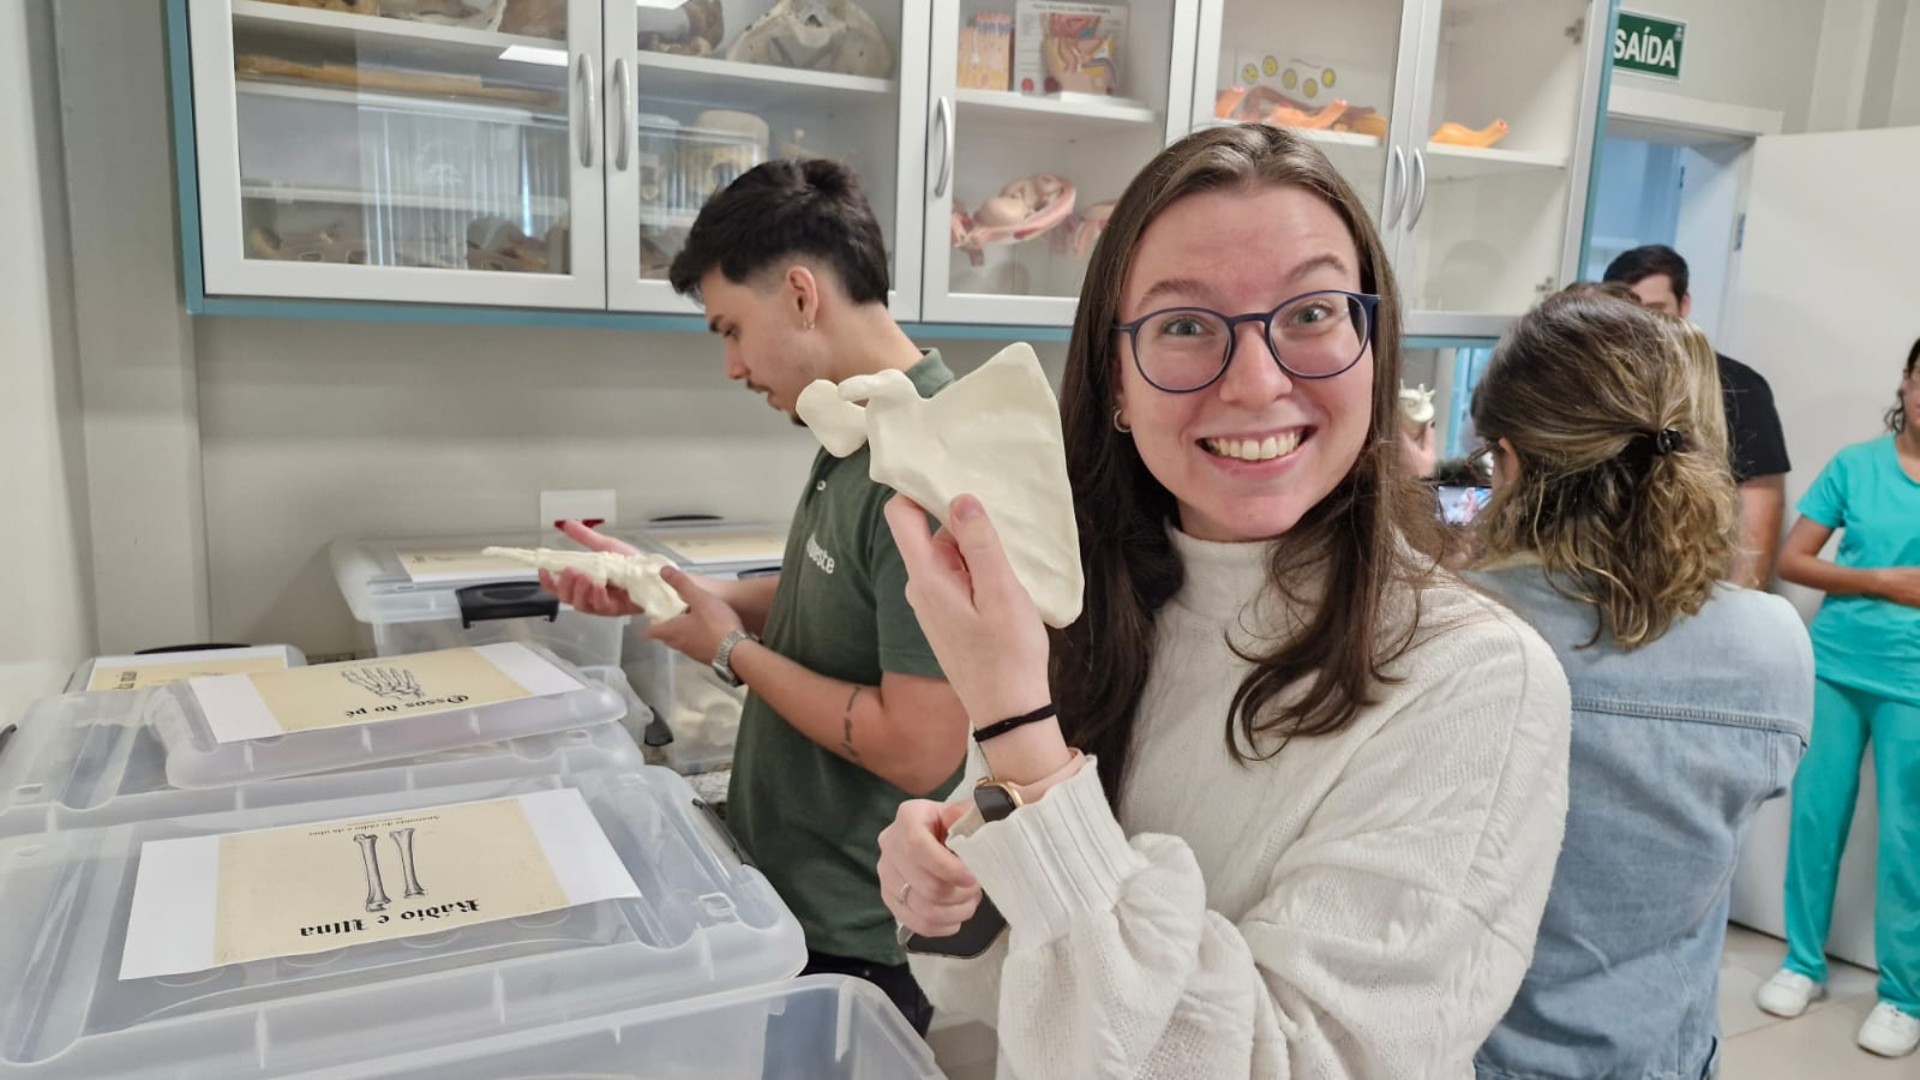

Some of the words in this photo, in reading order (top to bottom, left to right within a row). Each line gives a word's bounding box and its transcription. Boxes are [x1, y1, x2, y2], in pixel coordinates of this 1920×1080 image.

[1614, 26, 1676, 68] SAÍDA
[405, 695, 469, 708] Ossos
[345, 707, 368, 718] pé
[374, 704, 398, 713] do
[400, 899, 480, 921] Rádio
[378, 914, 390, 925] e
[300, 918, 368, 937] Ulna
